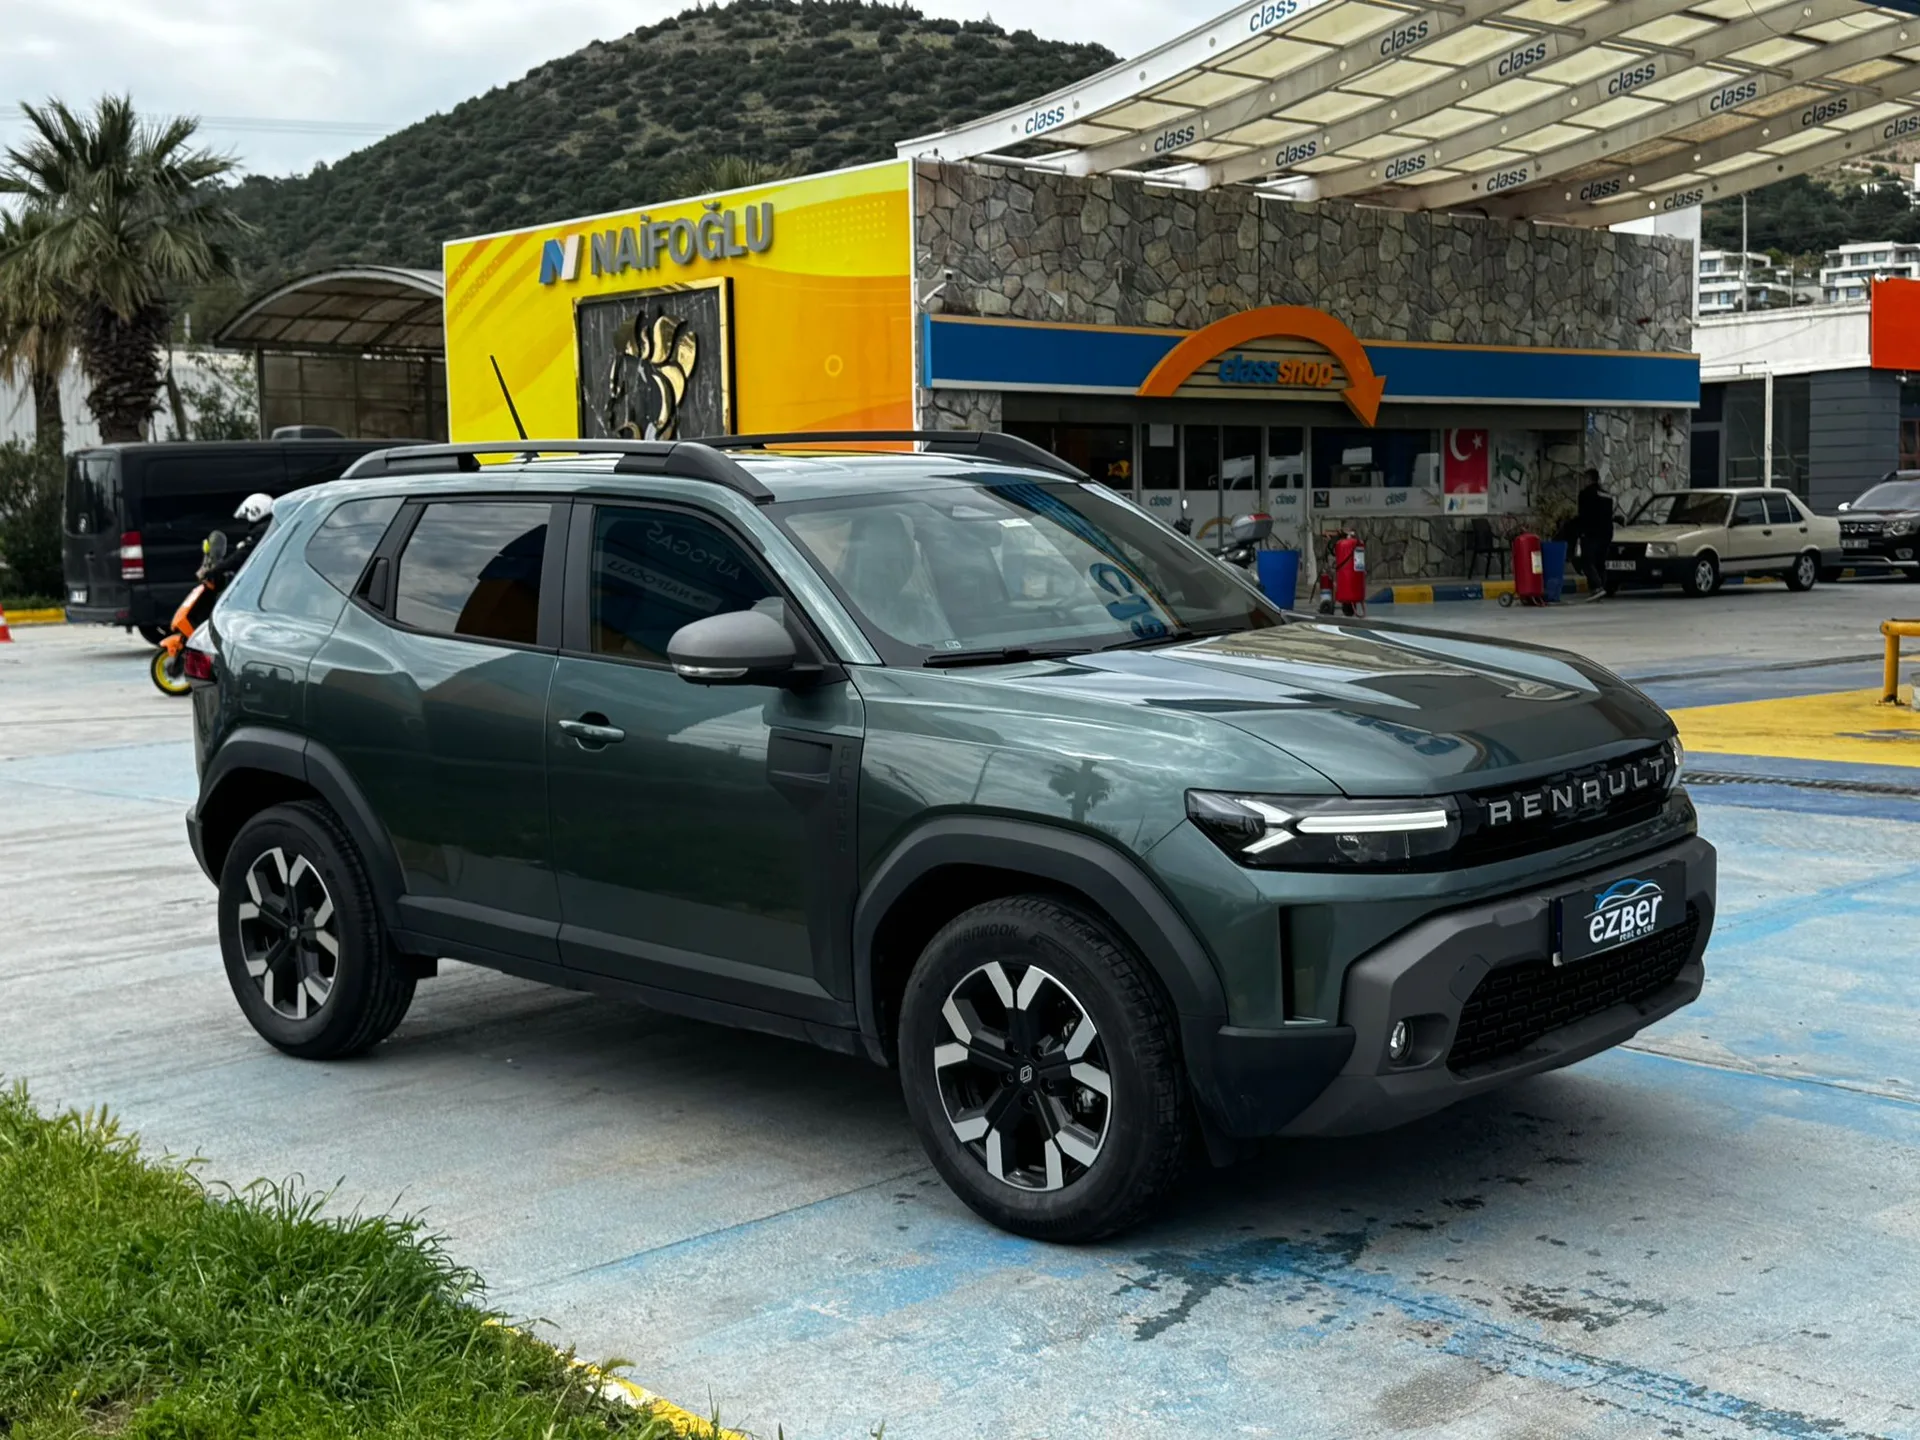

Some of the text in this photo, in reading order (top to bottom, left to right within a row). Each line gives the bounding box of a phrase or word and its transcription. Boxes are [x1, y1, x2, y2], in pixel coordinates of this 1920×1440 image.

[1249, 0, 1297, 32] class
[1379, 19, 1430, 57] class
[1498, 41, 1547, 77] class
[1607, 62, 1657, 96] class
[1709, 81, 1757, 112] class
[1024, 105, 1066, 135] class
[1801, 97, 1849, 127] class
[1884, 115, 1920, 139] clas
[1153, 123, 1196, 153] class
[1275, 140, 1317, 167] class
[1384, 153, 1427, 180] class
[1486, 167, 1528, 193] class
[1579, 176, 1621, 202] class
[1663, 186, 1704, 211] class
[591, 201, 774, 276] NAİFOĞLU
[1489, 758, 1664, 826] RENAULT
